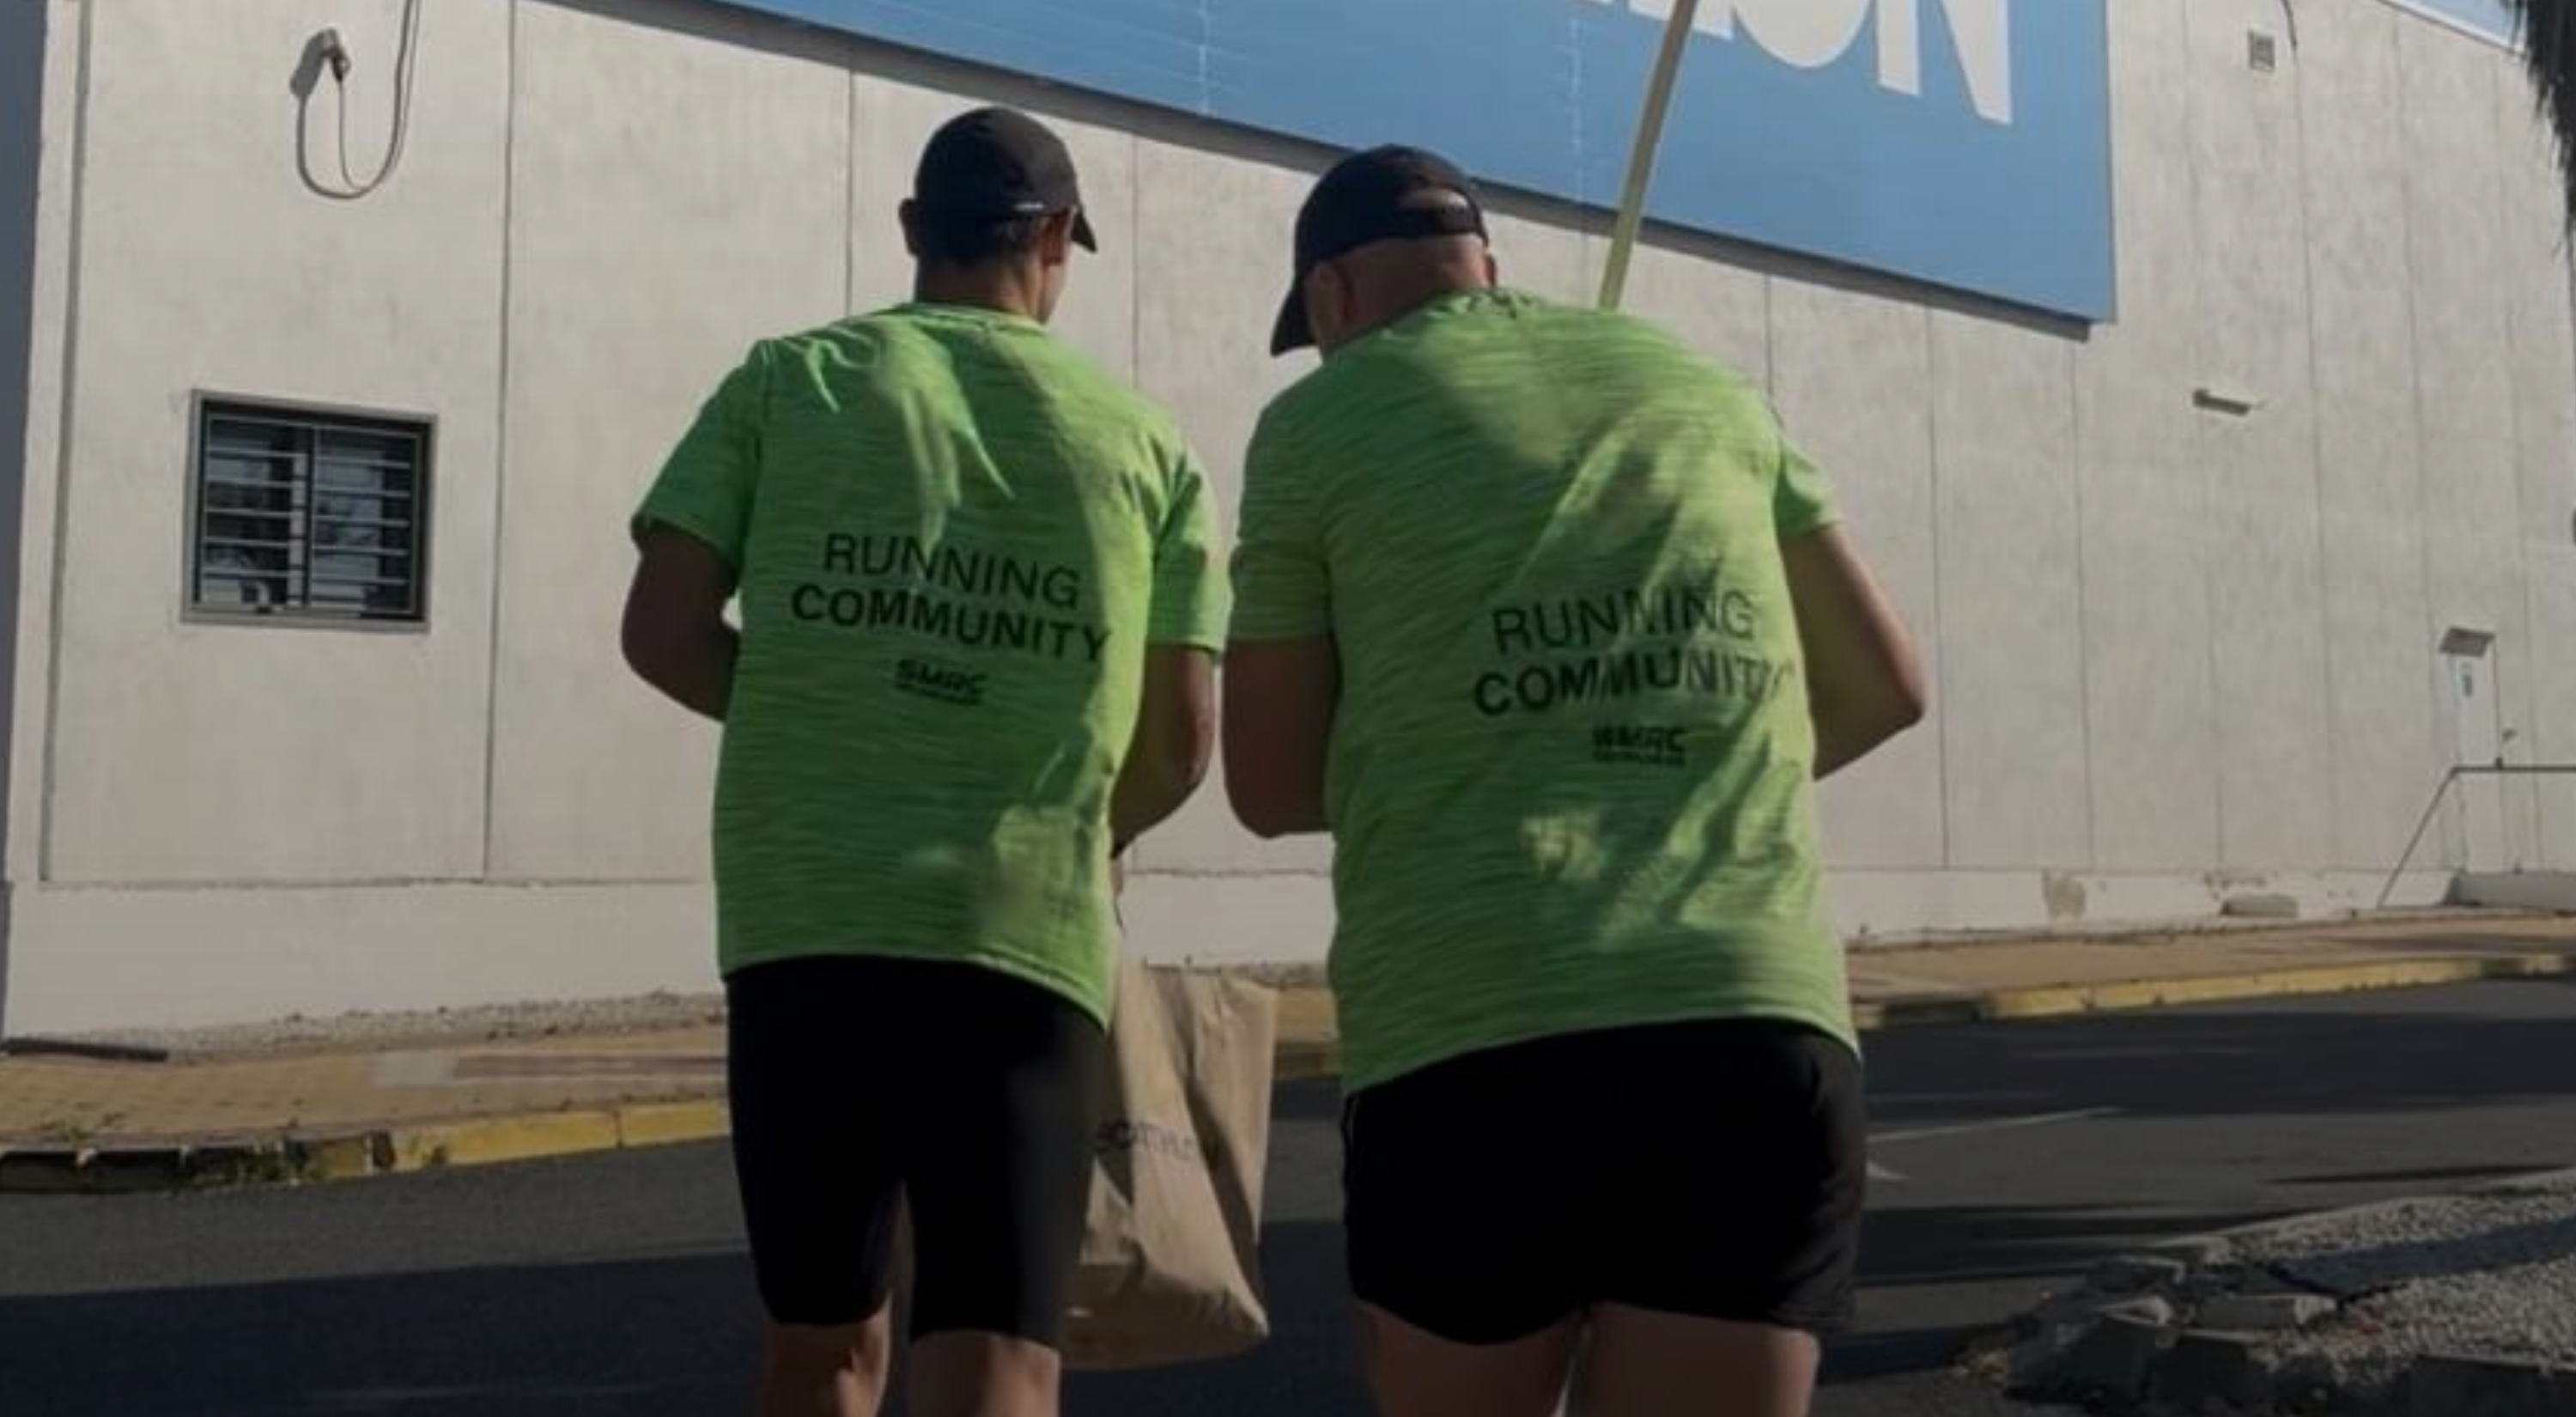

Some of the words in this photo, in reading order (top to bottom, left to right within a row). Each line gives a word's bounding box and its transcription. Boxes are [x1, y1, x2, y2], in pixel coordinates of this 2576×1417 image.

[823, 532, 1079, 611] RUNNING
[791, 582, 1111, 662] COMMUNITY
[1492, 587, 1754, 655] RUNNING
[1473, 646, 1795, 715] COMMUNITY
